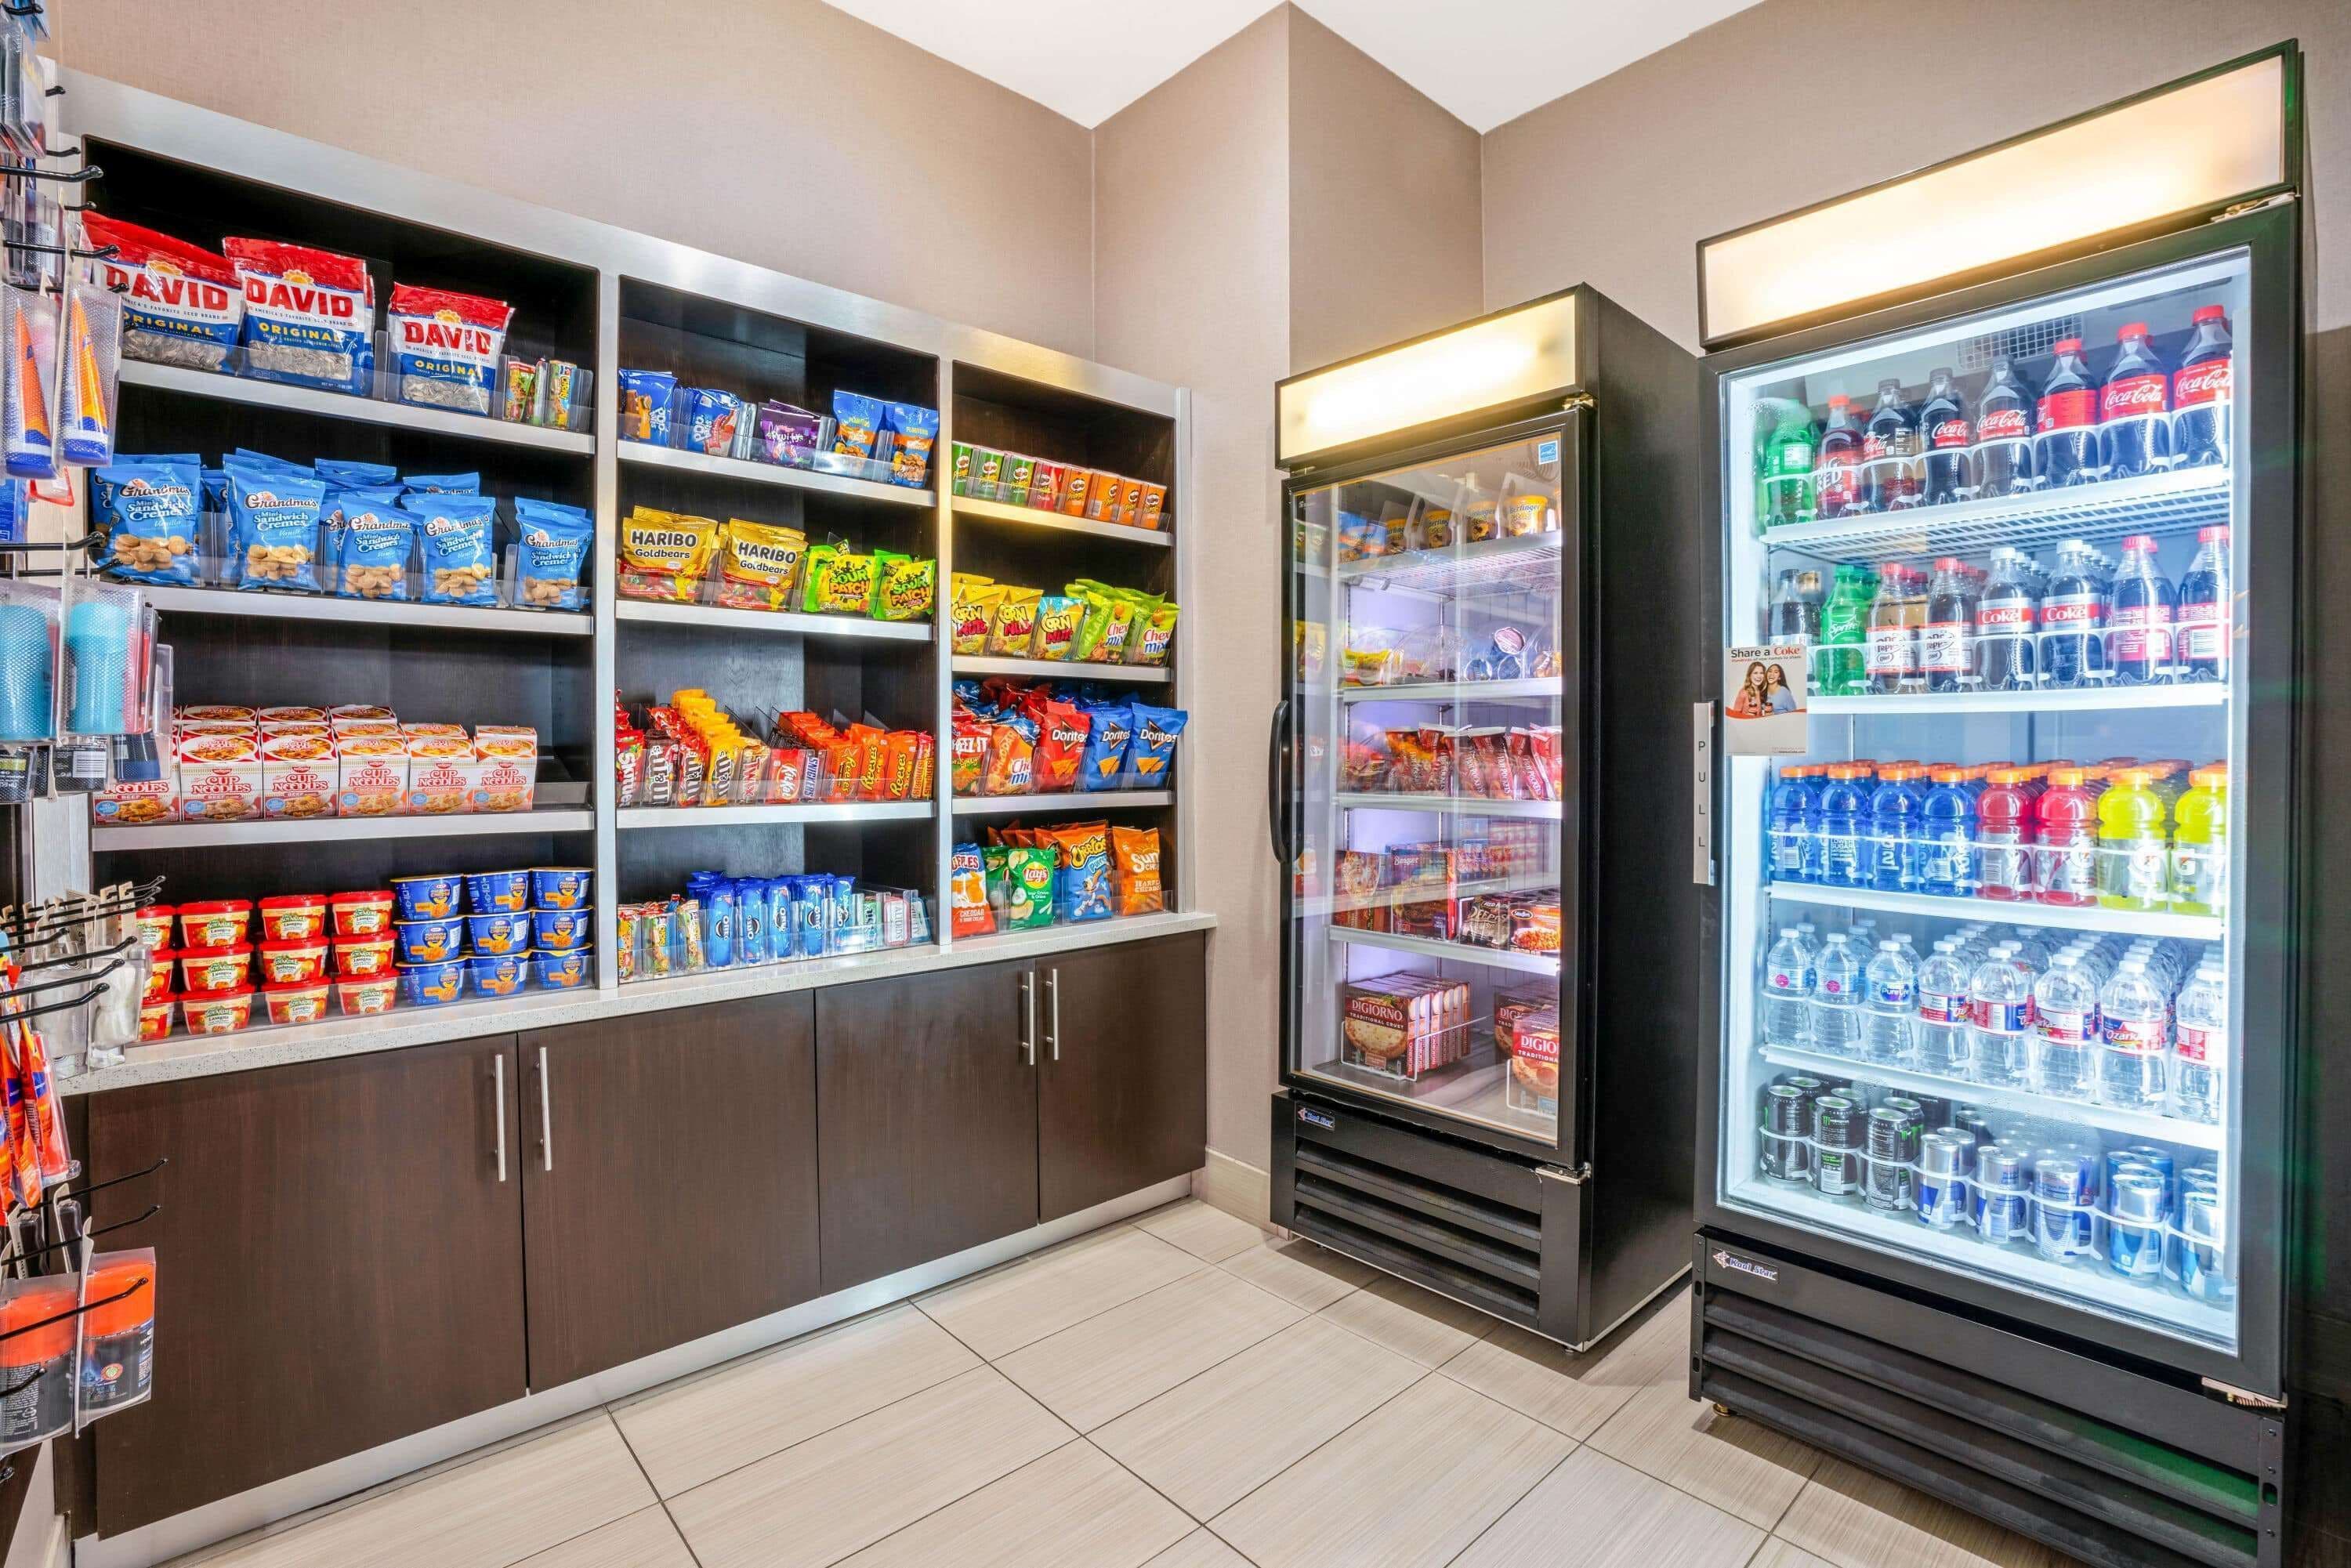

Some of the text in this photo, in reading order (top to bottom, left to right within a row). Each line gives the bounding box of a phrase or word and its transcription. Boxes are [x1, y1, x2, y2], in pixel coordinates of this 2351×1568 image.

[103, 265, 229, 311] DAVID
[245, 277, 353, 318] DAVID
[402, 321, 492, 355] DAVID
[2104, 383, 2163, 411] Coca-Cola
[1976, 408, 2028, 431] Coca-Cola
[244, 493, 319, 509] Grandma's
[129, 509, 183, 522] Cremes
[253, 512, 309, 523] Sandwich
[257, 519, 308, 531] Cremes
[355, 533, 400, 546] Sandwich
[358, 539, 399, 553] Cremes
[632, 531, 697, 548] HARIBO
[635, 548, 690, 559] Goldbears
[738, 541, 796, 564] HARIBO
[740, 559, 790, 576] Goldbears
[831, 569, 868, 585] SOUR
[829, 580, 870, 594] PATCH
[893, 574, 929, 595] SOUR
[890, 587, 930, 607] PATCH
[998, 603, 1027, 624] CORN
[1980, 609, 2020, 624] Coke
[2046, 604, 2087, 621] Coke
[1041, 613, 1073, 632] CORN
[1107, 622, 1128, 636] Chex
[1143, 629, 1171, 643] Chex
[1144, 643, 1168, 654] mix
[1731, 649, 1762, 658] Share
[1773, 646, 1800, 656] Coke
[1052, 730, 1088, 744] Doritos
[1103, 730, 1131, 743] Doritos
[1140, 730, 1179, 744] Doritos
[286, 773, 318, 783] CUP
[361, 769, 391, 778] CUP
[430, 770, 458, 779] CUP
[493, 769, 520, 778] CUP
[890, 752, 907, 798] Reese's
[205, 777, 240, 785] CUP
[273, 781, 329, 791] NOODLES
[349, 776, 401, 786] NOODLES
[418, 777, 467, 788] NOODLES
[481, 776, 527, 786] NOODLES
[191, 784, 252, 795] NOODLES
[1131, 853, 1160, 873] Sun
[1025, 868, 1049, 882] Lay's
[1882, 987, 1900, 996] Pure
[1351, 999, 1404, 1022] DIGIORNO
[1349, 1012, 1405, 1030] TRADITIONAL CRUST
[1730, 1258, 1777, 1280] Kool Star
